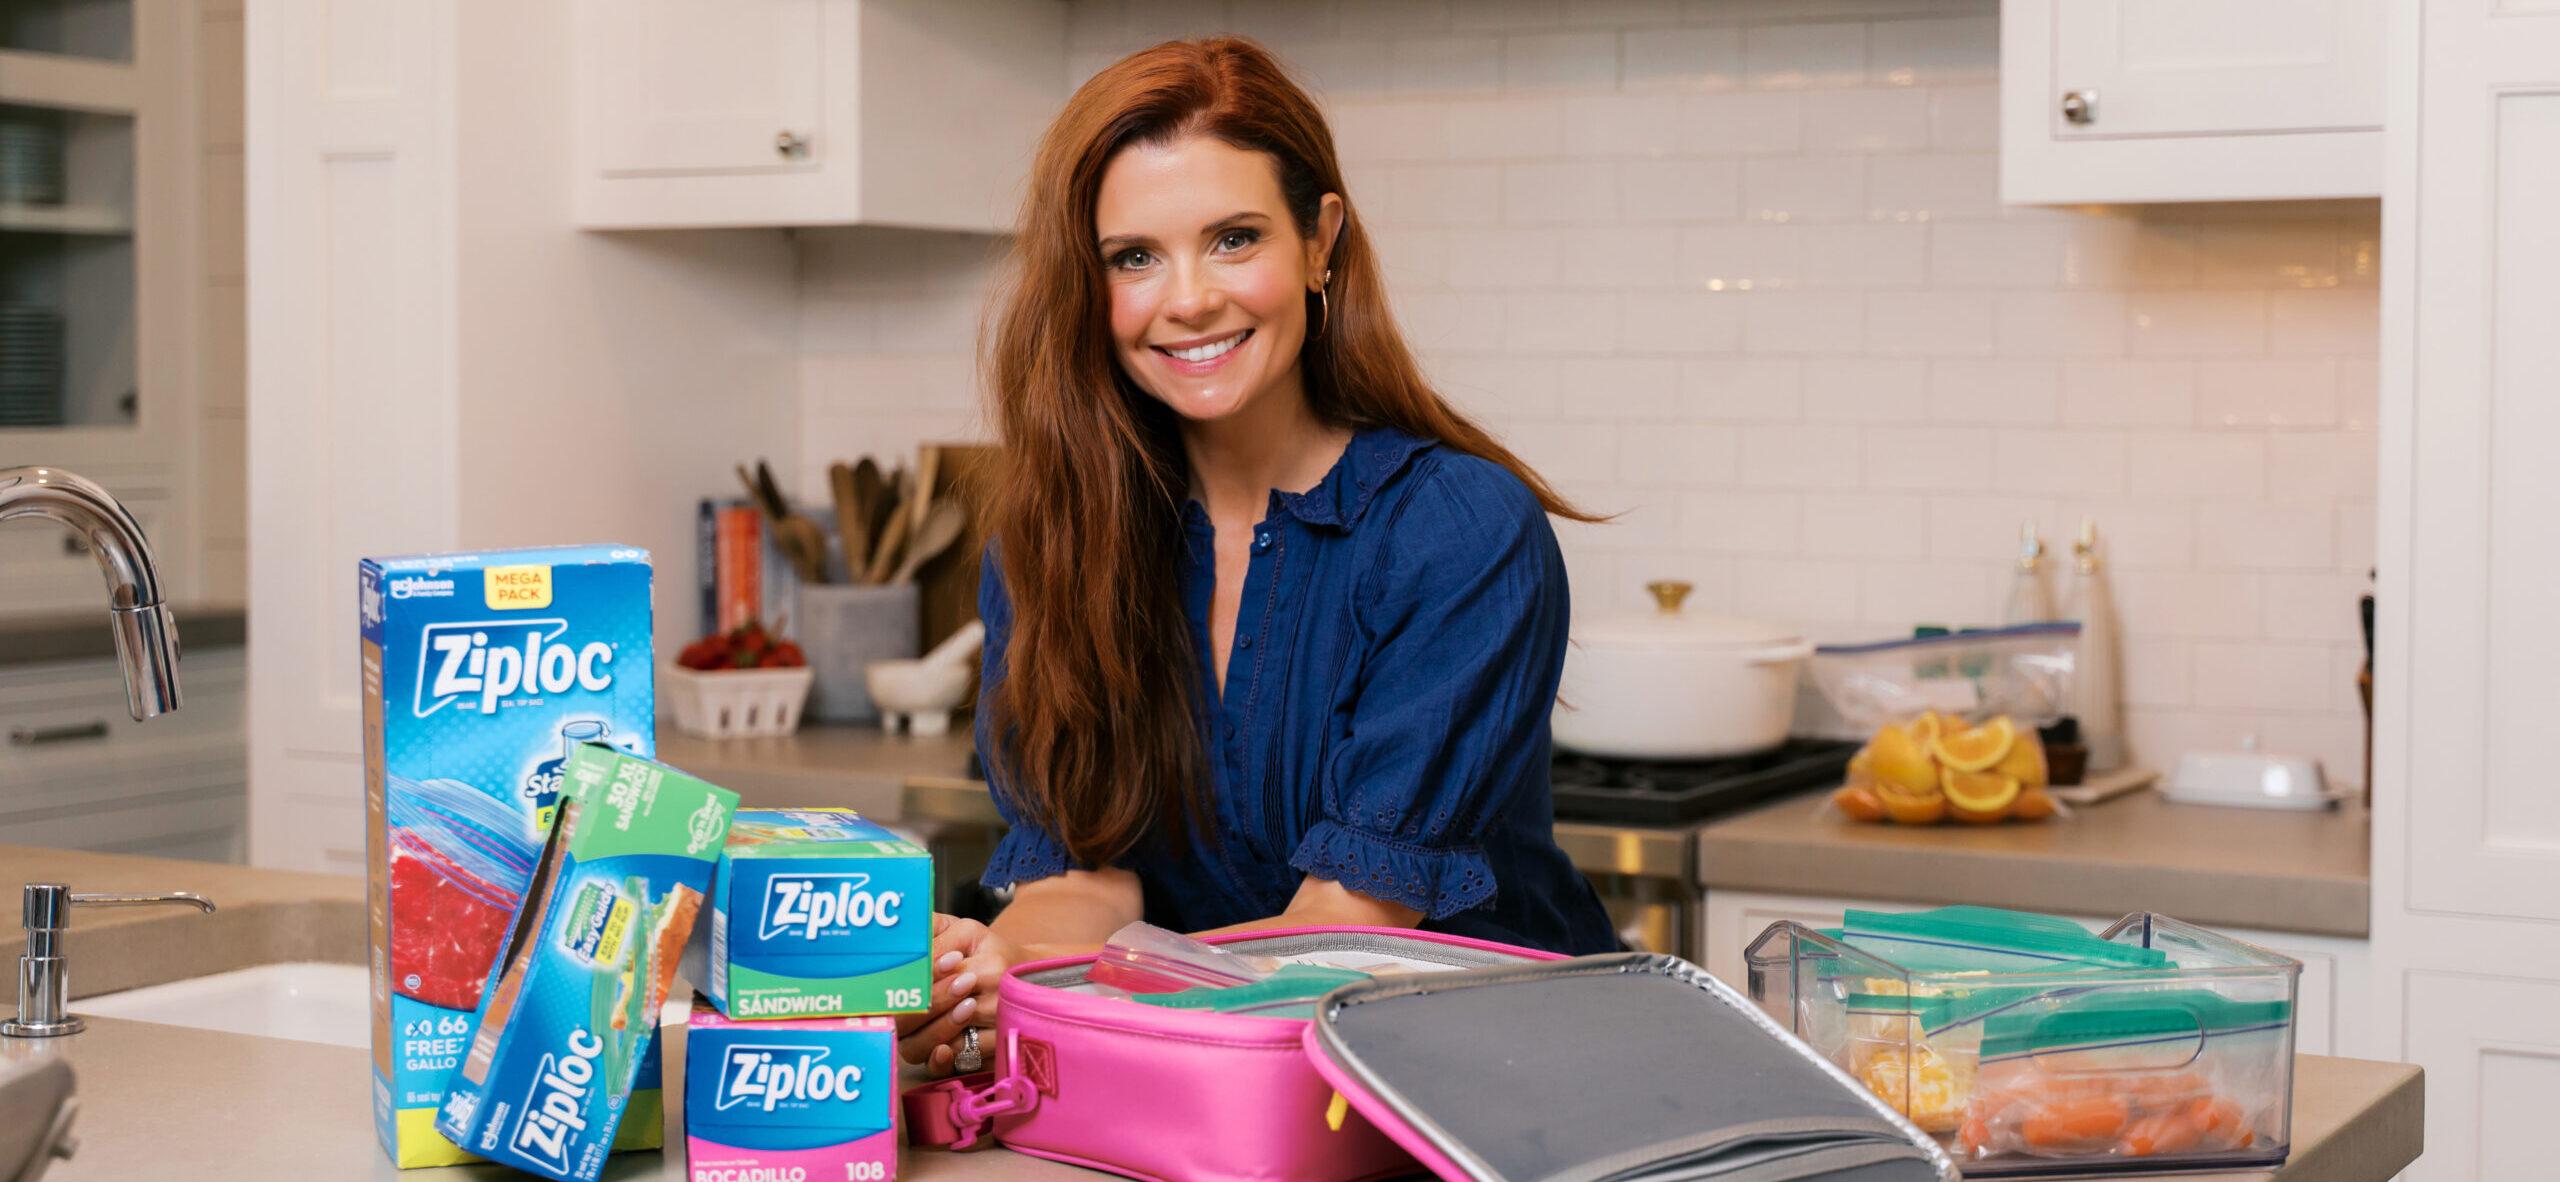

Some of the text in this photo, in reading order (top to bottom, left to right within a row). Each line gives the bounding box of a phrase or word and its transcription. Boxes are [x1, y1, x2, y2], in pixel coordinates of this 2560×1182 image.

[495, 573, 542, 586] MEGA
[499, 588, 541, 601] PACK
[433, 632, 613, 714] Ziploc
[525, 772, 564, 798] Sta
[606, 761, 637, 807] 30 XL
[772, 880, 901, 940] Ziploc
[885, 988, 922, 1008] 105
[437, 1015, 469, 1035] 66
[406, 1057, 457, 1071] GALLO
[730, 1052, 863, 1112] Ziploc
[519, 1029, 603, 1159] Ziploc
[695, 1166, 807, 1182] BOCADILLO
[845, 1161, 886, 1181] 108
